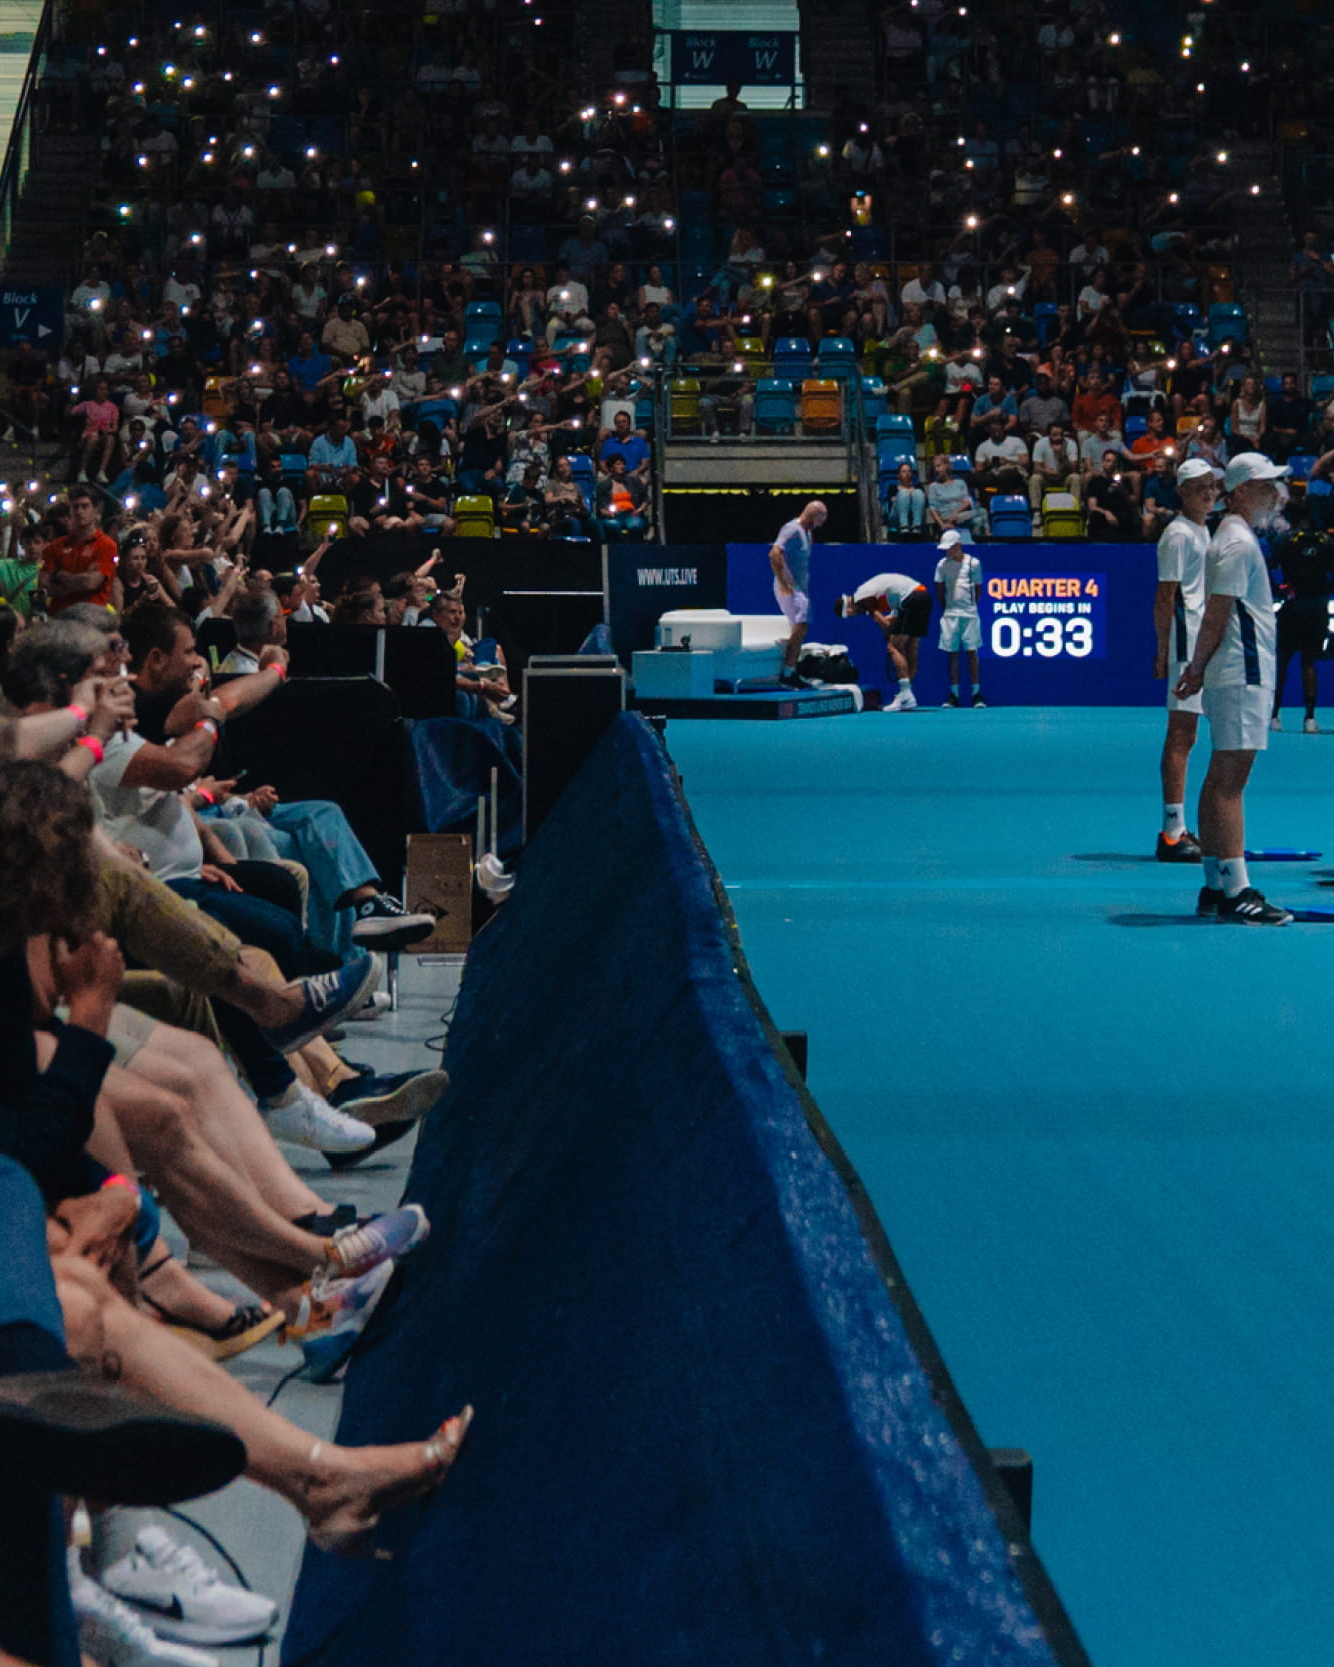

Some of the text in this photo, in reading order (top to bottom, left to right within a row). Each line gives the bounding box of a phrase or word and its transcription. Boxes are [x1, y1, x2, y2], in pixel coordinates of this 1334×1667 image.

[692, 50, 715, 69] W
[755, 50, 779, 69] W
[3, 291, 37, 304] Block
[14, 307, 31, 328] V
[988, 578, 1099, 599] QUARTER 4
[993, 602, 1091, 614] PLAY BEGINS IN
[991, 617, 1093, 657] 0:33
